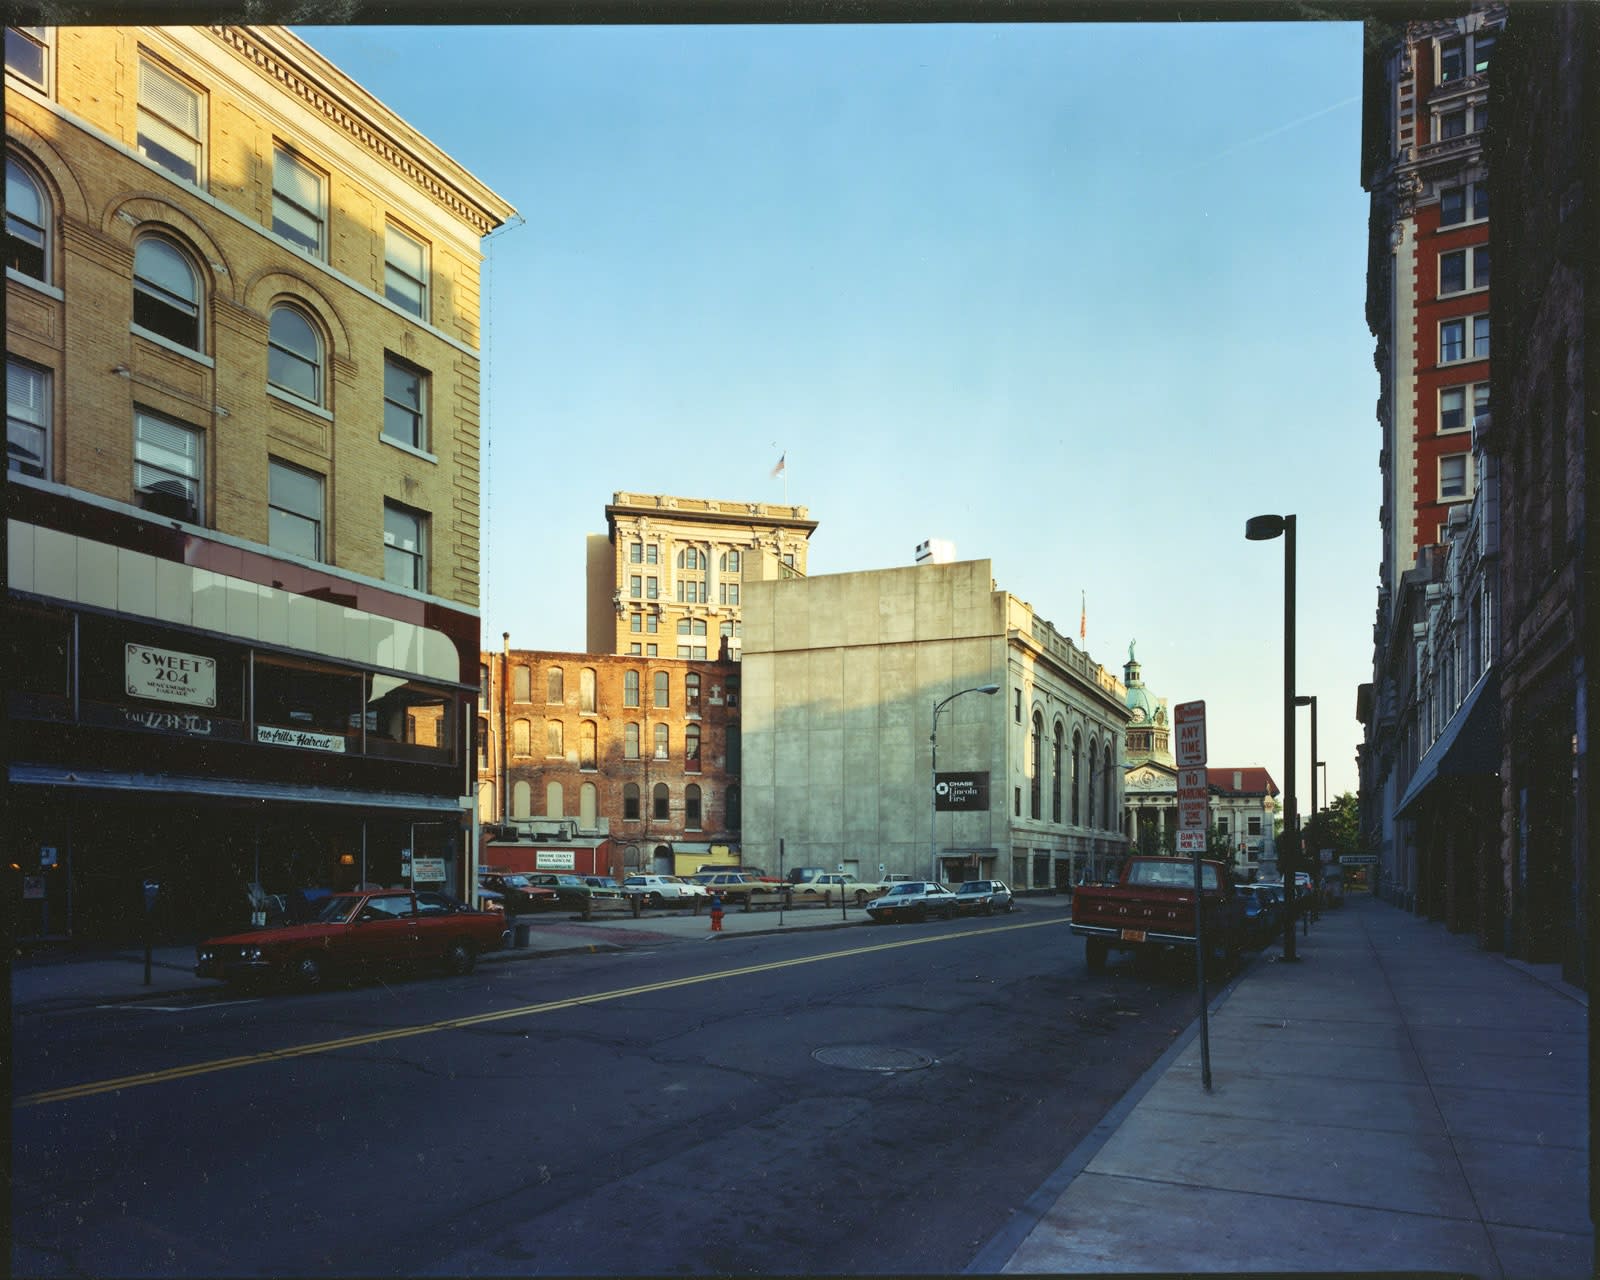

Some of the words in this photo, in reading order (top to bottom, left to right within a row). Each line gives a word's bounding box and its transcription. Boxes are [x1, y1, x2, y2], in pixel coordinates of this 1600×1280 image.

[141, 652, 201, 672] SWEET
[155, 668, 188, 684] 204
[1181, 725, 1200, 739] ANY
[297, 734, 331, 748] Haircut
[1181, 740, 1201, 754] TIME
[1185, 774, 1198, 786] NO
[1179, 787, 1206, 800] PARKING
[1097, 905, 1176, 919] OD
